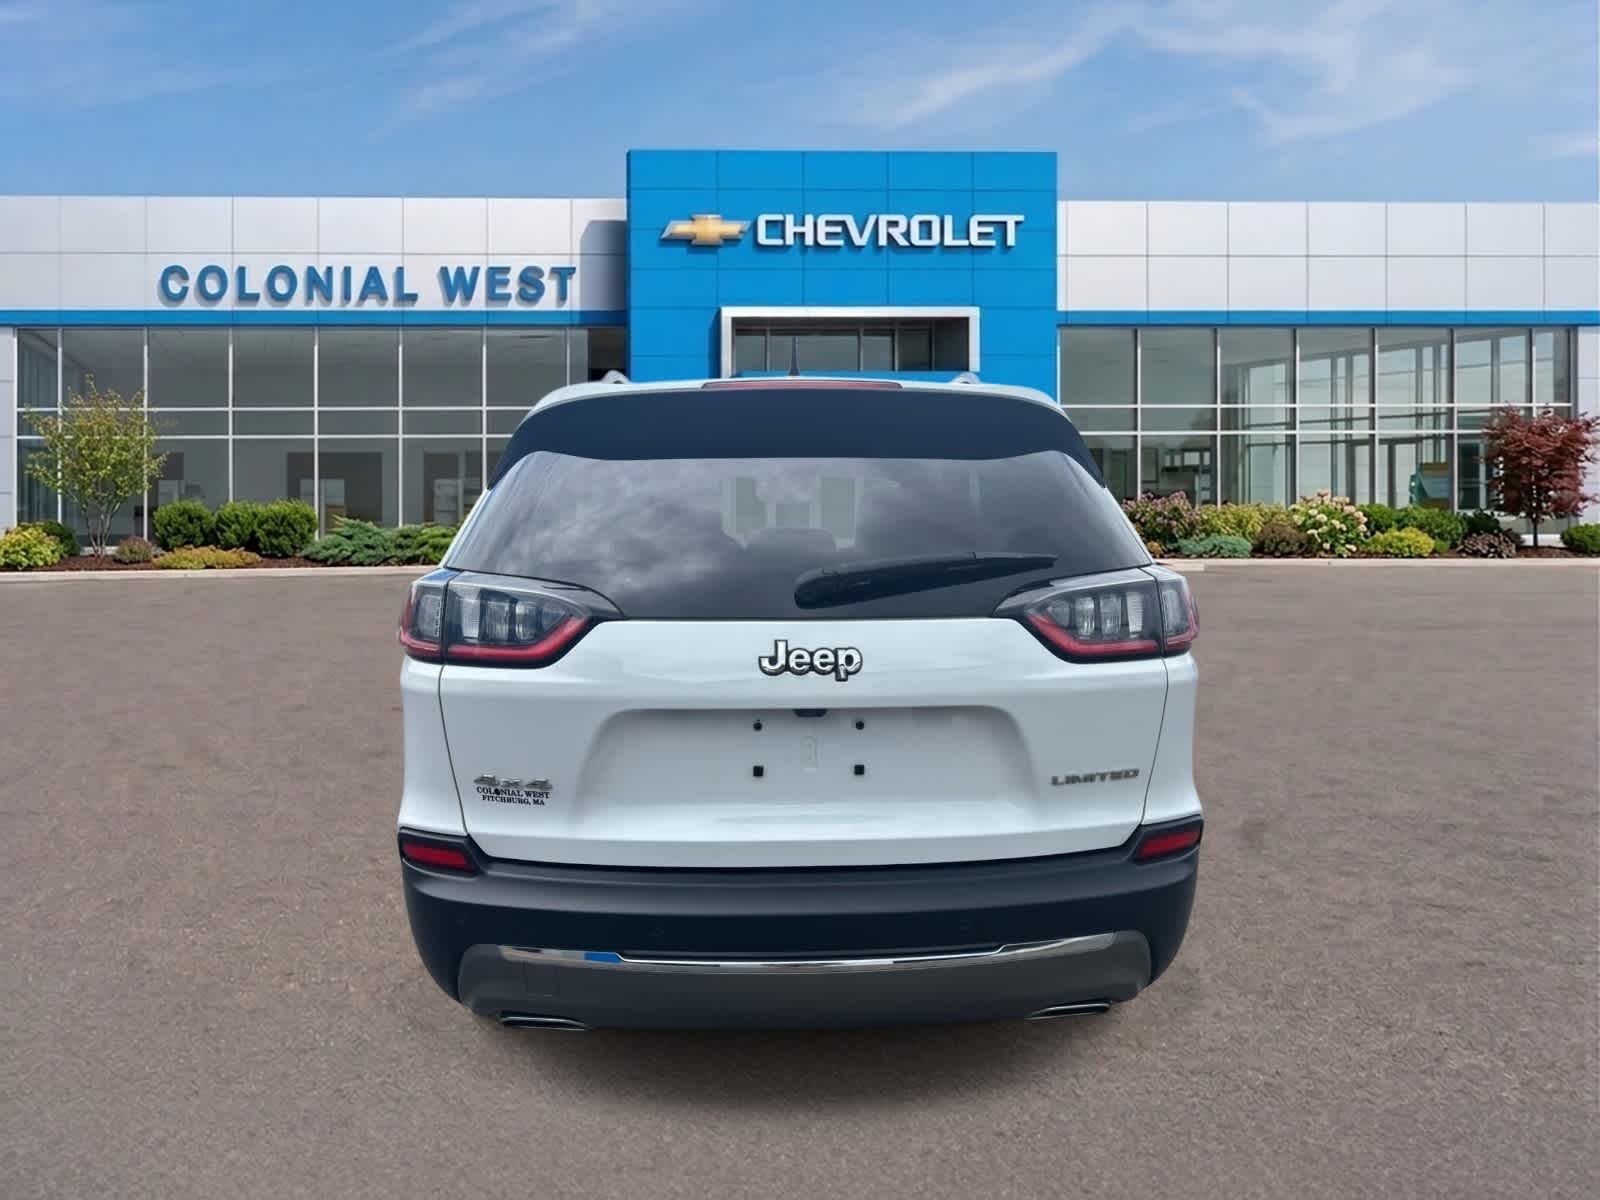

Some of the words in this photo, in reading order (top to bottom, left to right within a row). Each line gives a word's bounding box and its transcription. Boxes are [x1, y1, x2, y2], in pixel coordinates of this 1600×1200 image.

[756, 213, 1025, 248] CHEVROLET
[159, 264, 418, 306] COLONIAL
[439, 265, 577, 304] WEST
[758, 639, 864, 681] Jeep
[1051, 768, 1139, 785] LIMITED
[476, 786, 522, 797] COLONIAL
[524, 790, 550, 799] WEST
[482, 795, 531, 805] FITCHBURG,
